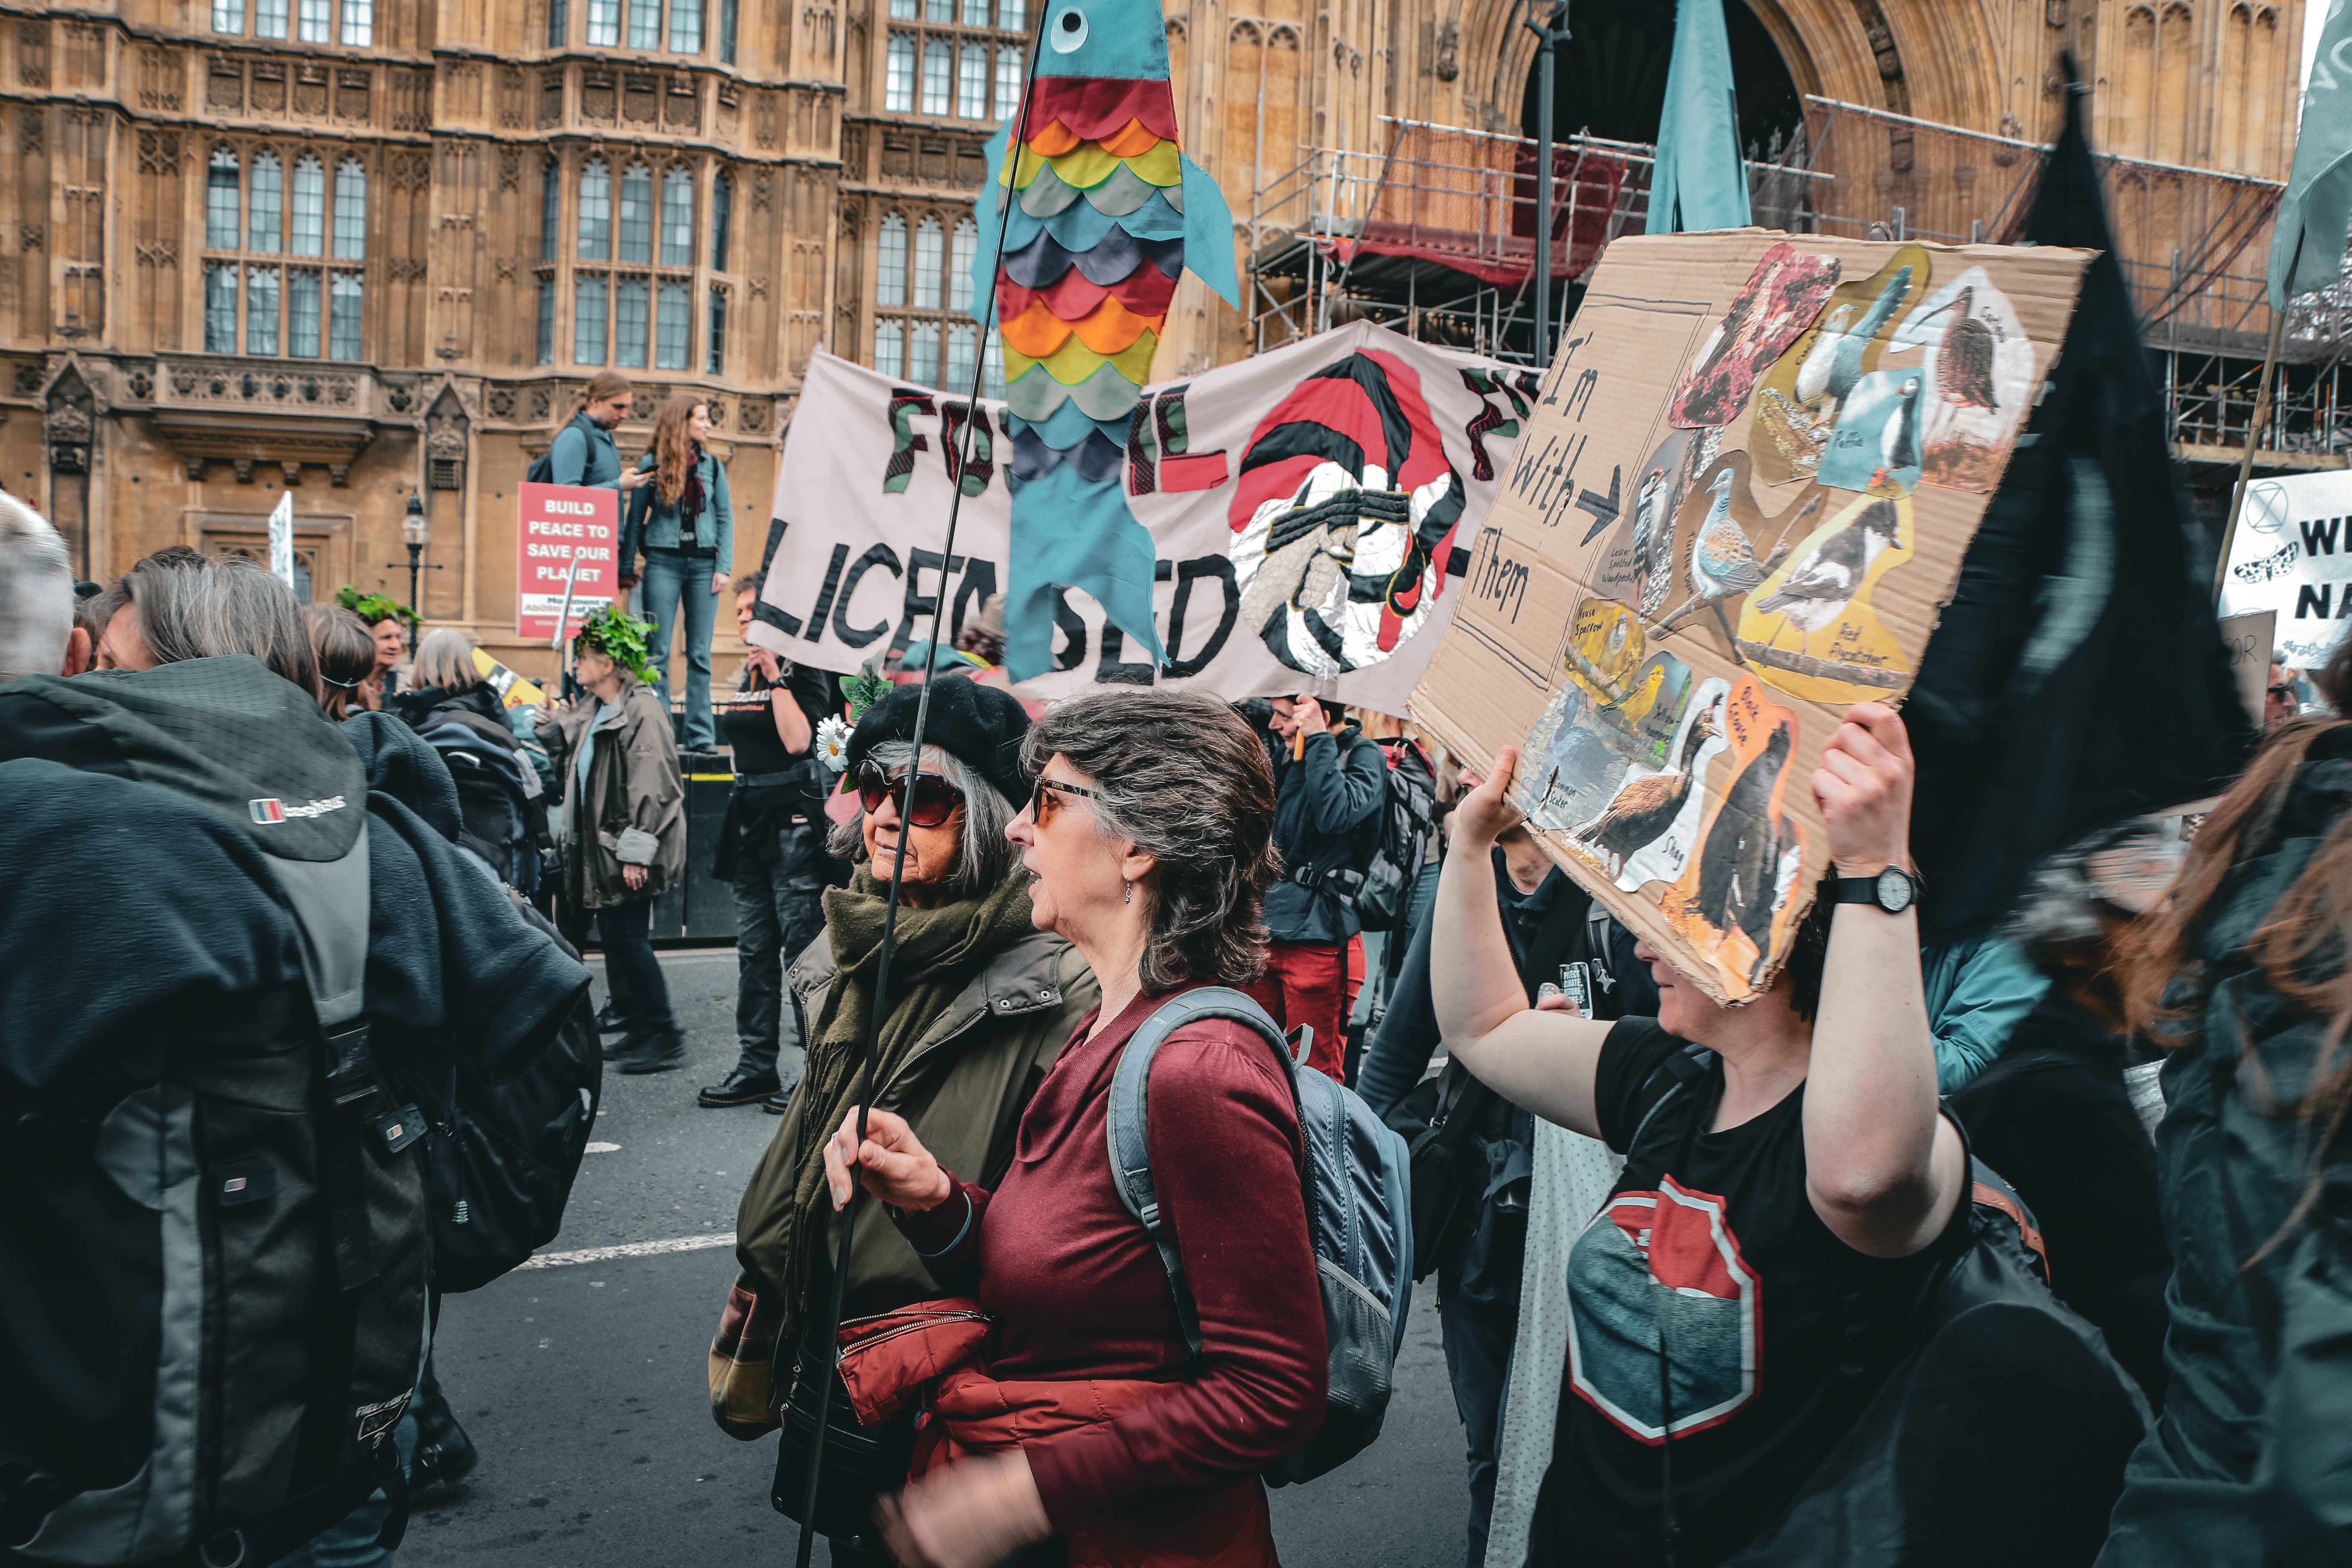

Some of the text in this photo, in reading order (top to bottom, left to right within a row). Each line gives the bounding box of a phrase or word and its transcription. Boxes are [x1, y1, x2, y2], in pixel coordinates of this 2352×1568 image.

[1542, 331, 1599, 423] I'm
[883, 387, 1229, 497] FOIL
[1510, 432, 1588, 527] With
[545, 499, 596, 516] BUILD
[528, 521, 610, 539] PEACE TO
[2300, 515, 2352, 557] W
[527, 543, 611, 561] SAVE OUR
[1611, 548, 1631, 557] Lesser
[1608, 556, 1633, 571] Spotted
[1472, 527, 1529, 625] Them
[1577, 607, 1596, 621] House
[1574, 621, 1603, 640] Sparrow
[2225, 634, 2257, 665] OR
[1549, 790, 1568, 809] Scoter
[1661, 835, 1685, 872] Shag
